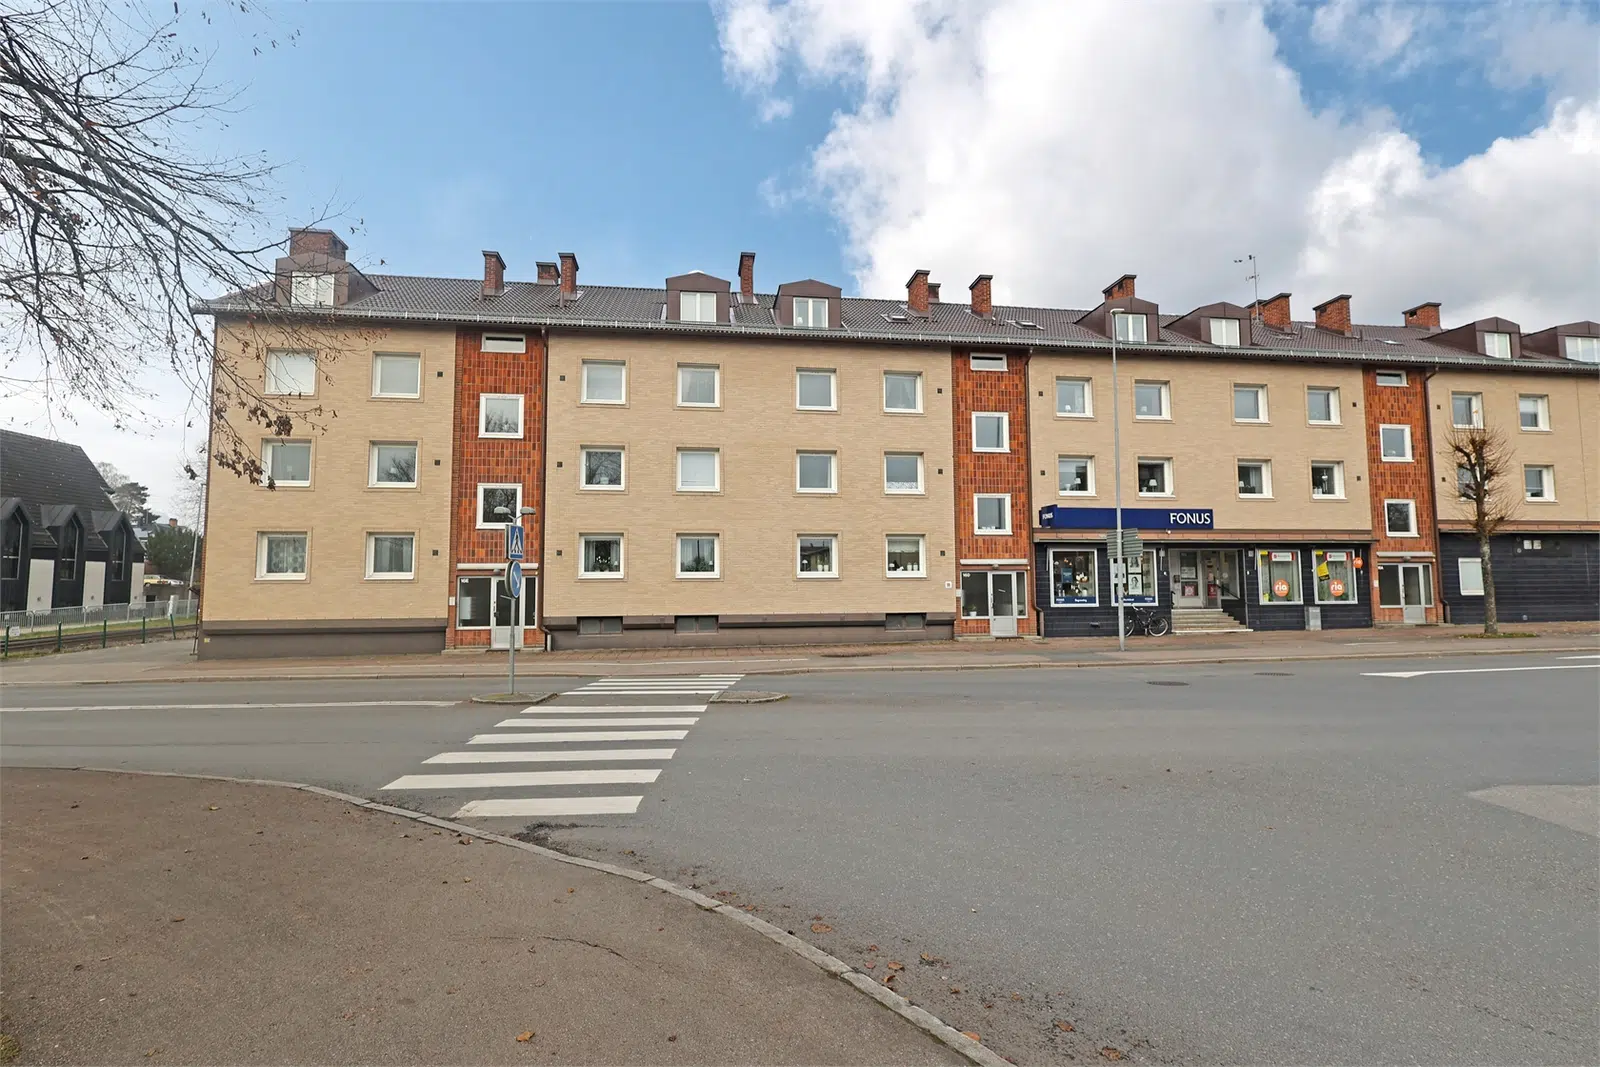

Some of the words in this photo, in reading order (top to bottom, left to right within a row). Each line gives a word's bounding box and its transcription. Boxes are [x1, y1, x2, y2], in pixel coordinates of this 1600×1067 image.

[1170, 512, 1211, 524] FONUS
[1275, 582, 1287, 590] ria
[1331, 582, 1343, 590] ria
